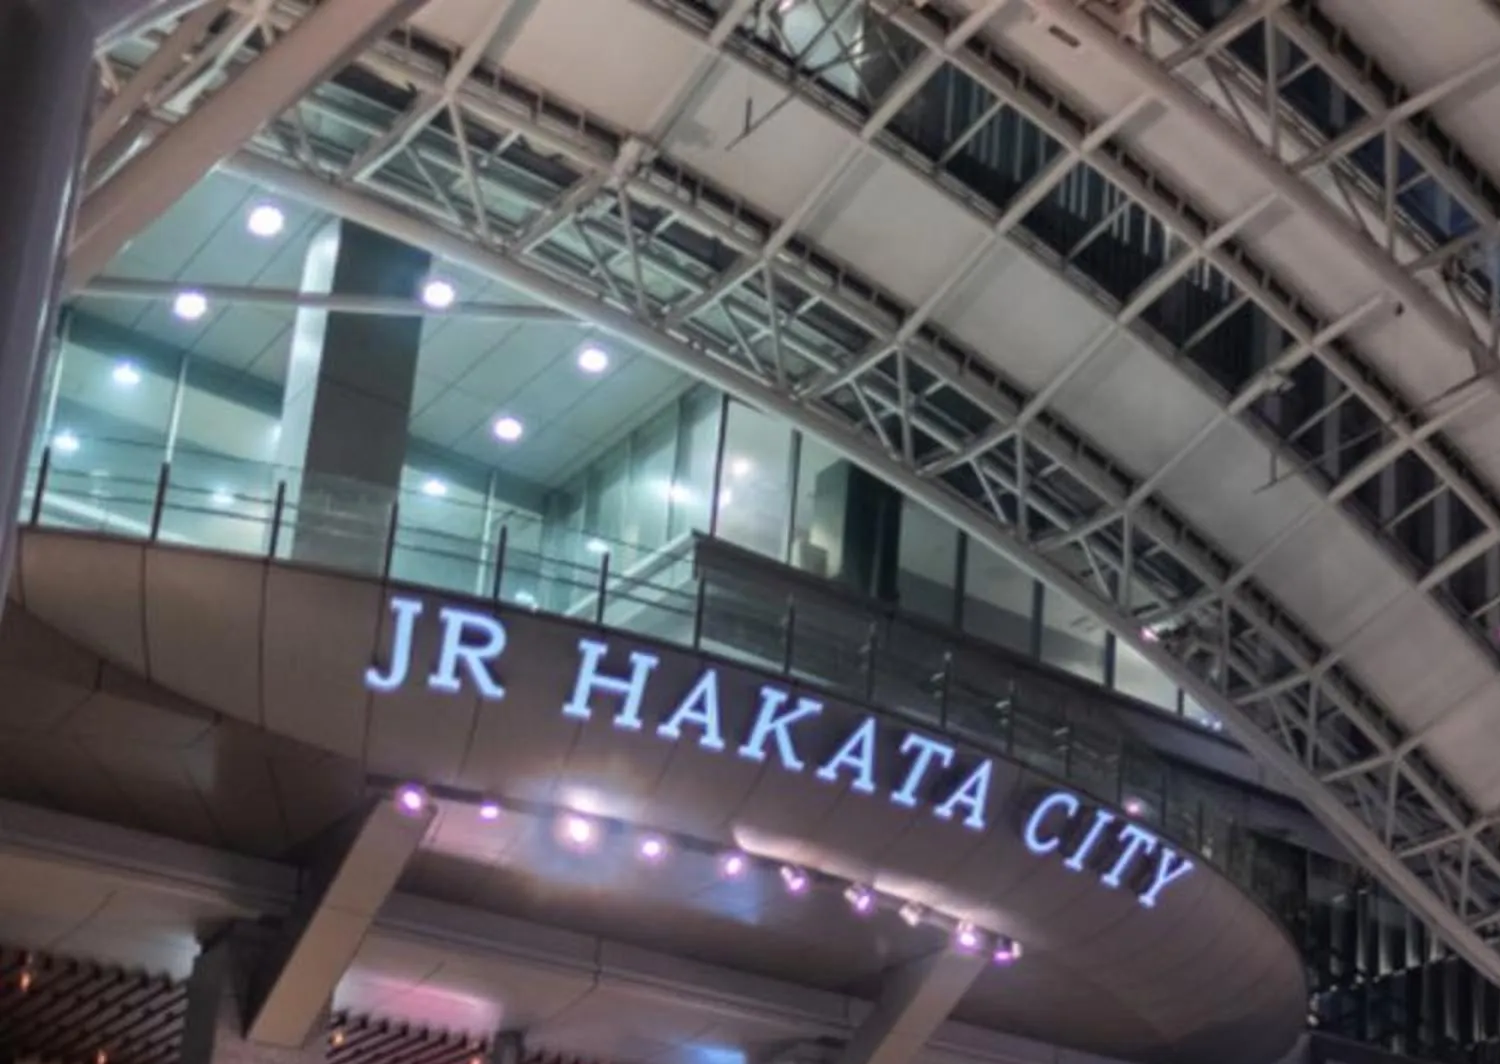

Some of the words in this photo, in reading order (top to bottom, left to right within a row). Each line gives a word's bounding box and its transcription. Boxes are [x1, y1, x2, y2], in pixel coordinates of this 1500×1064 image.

[365, 599, 506, 698] JR
[562, 638, 1000, 832] HAKATA
[1023, 791, 1194, 909] CITY
